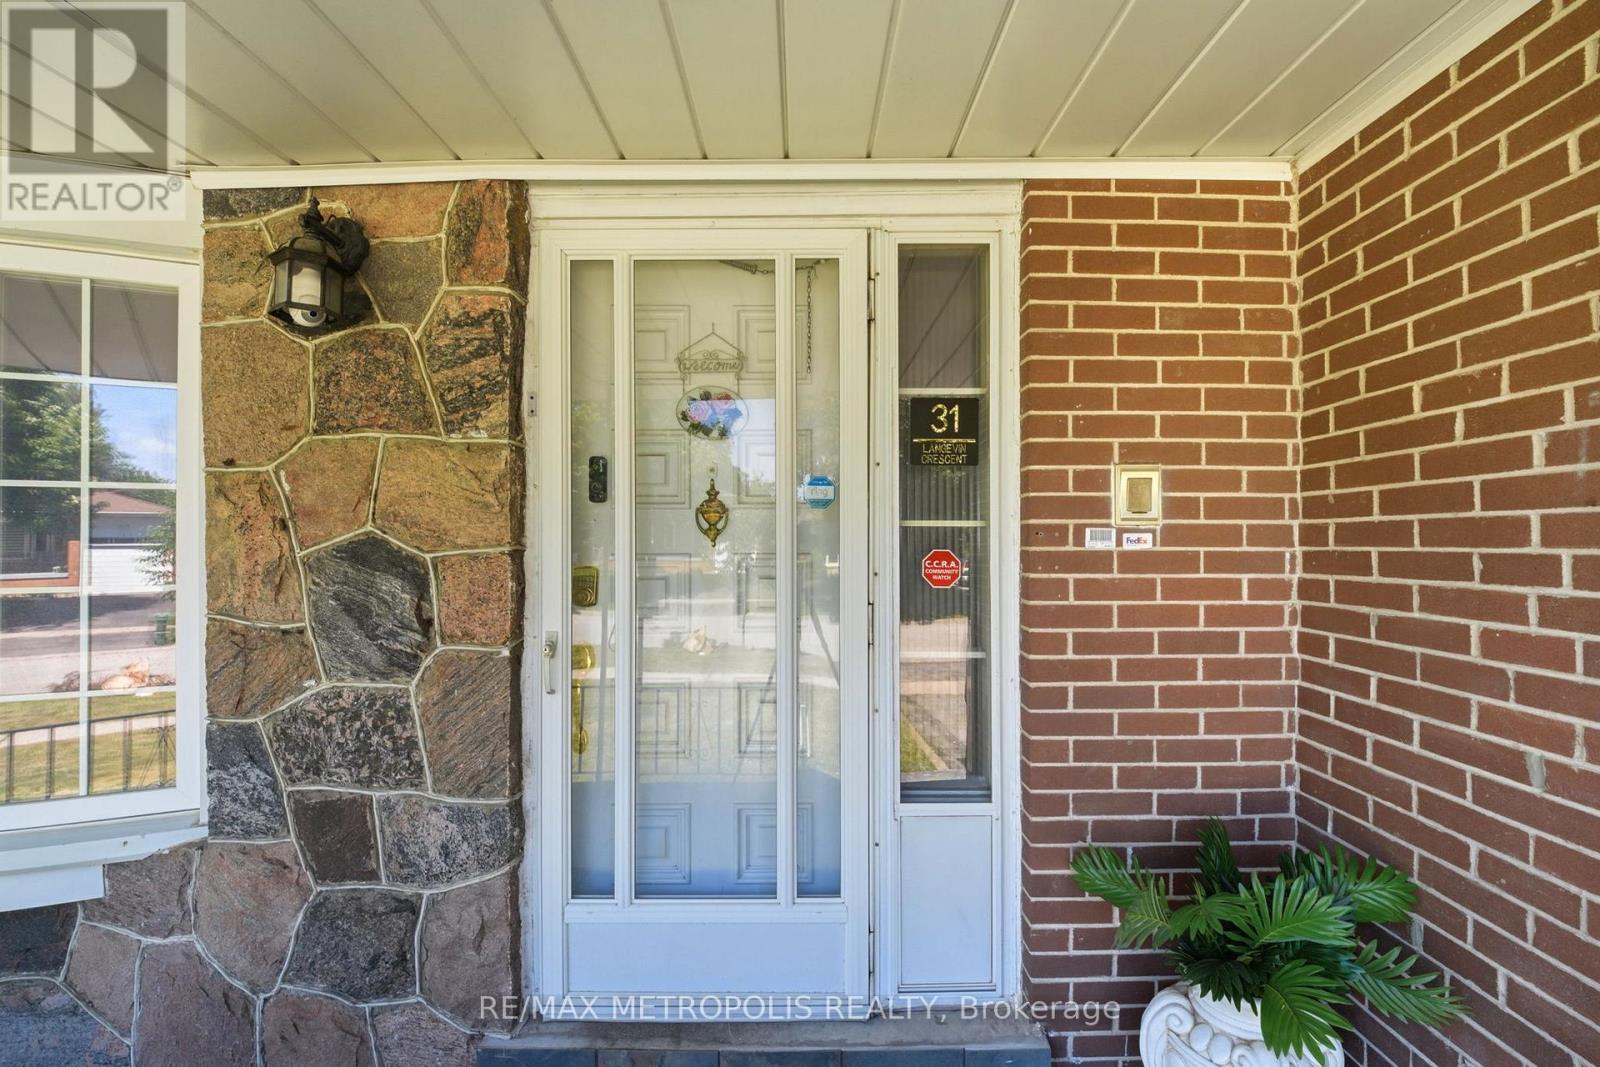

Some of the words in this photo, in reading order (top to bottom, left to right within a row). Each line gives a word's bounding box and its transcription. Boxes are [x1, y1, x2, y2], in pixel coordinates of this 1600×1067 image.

[930, 404, 959, 433] 31
[922, 443, 967, 454] LANGEVIN
[921, 454, 967, 465] CRESCENT
[1126, 536, 1147, 545] FedEx
